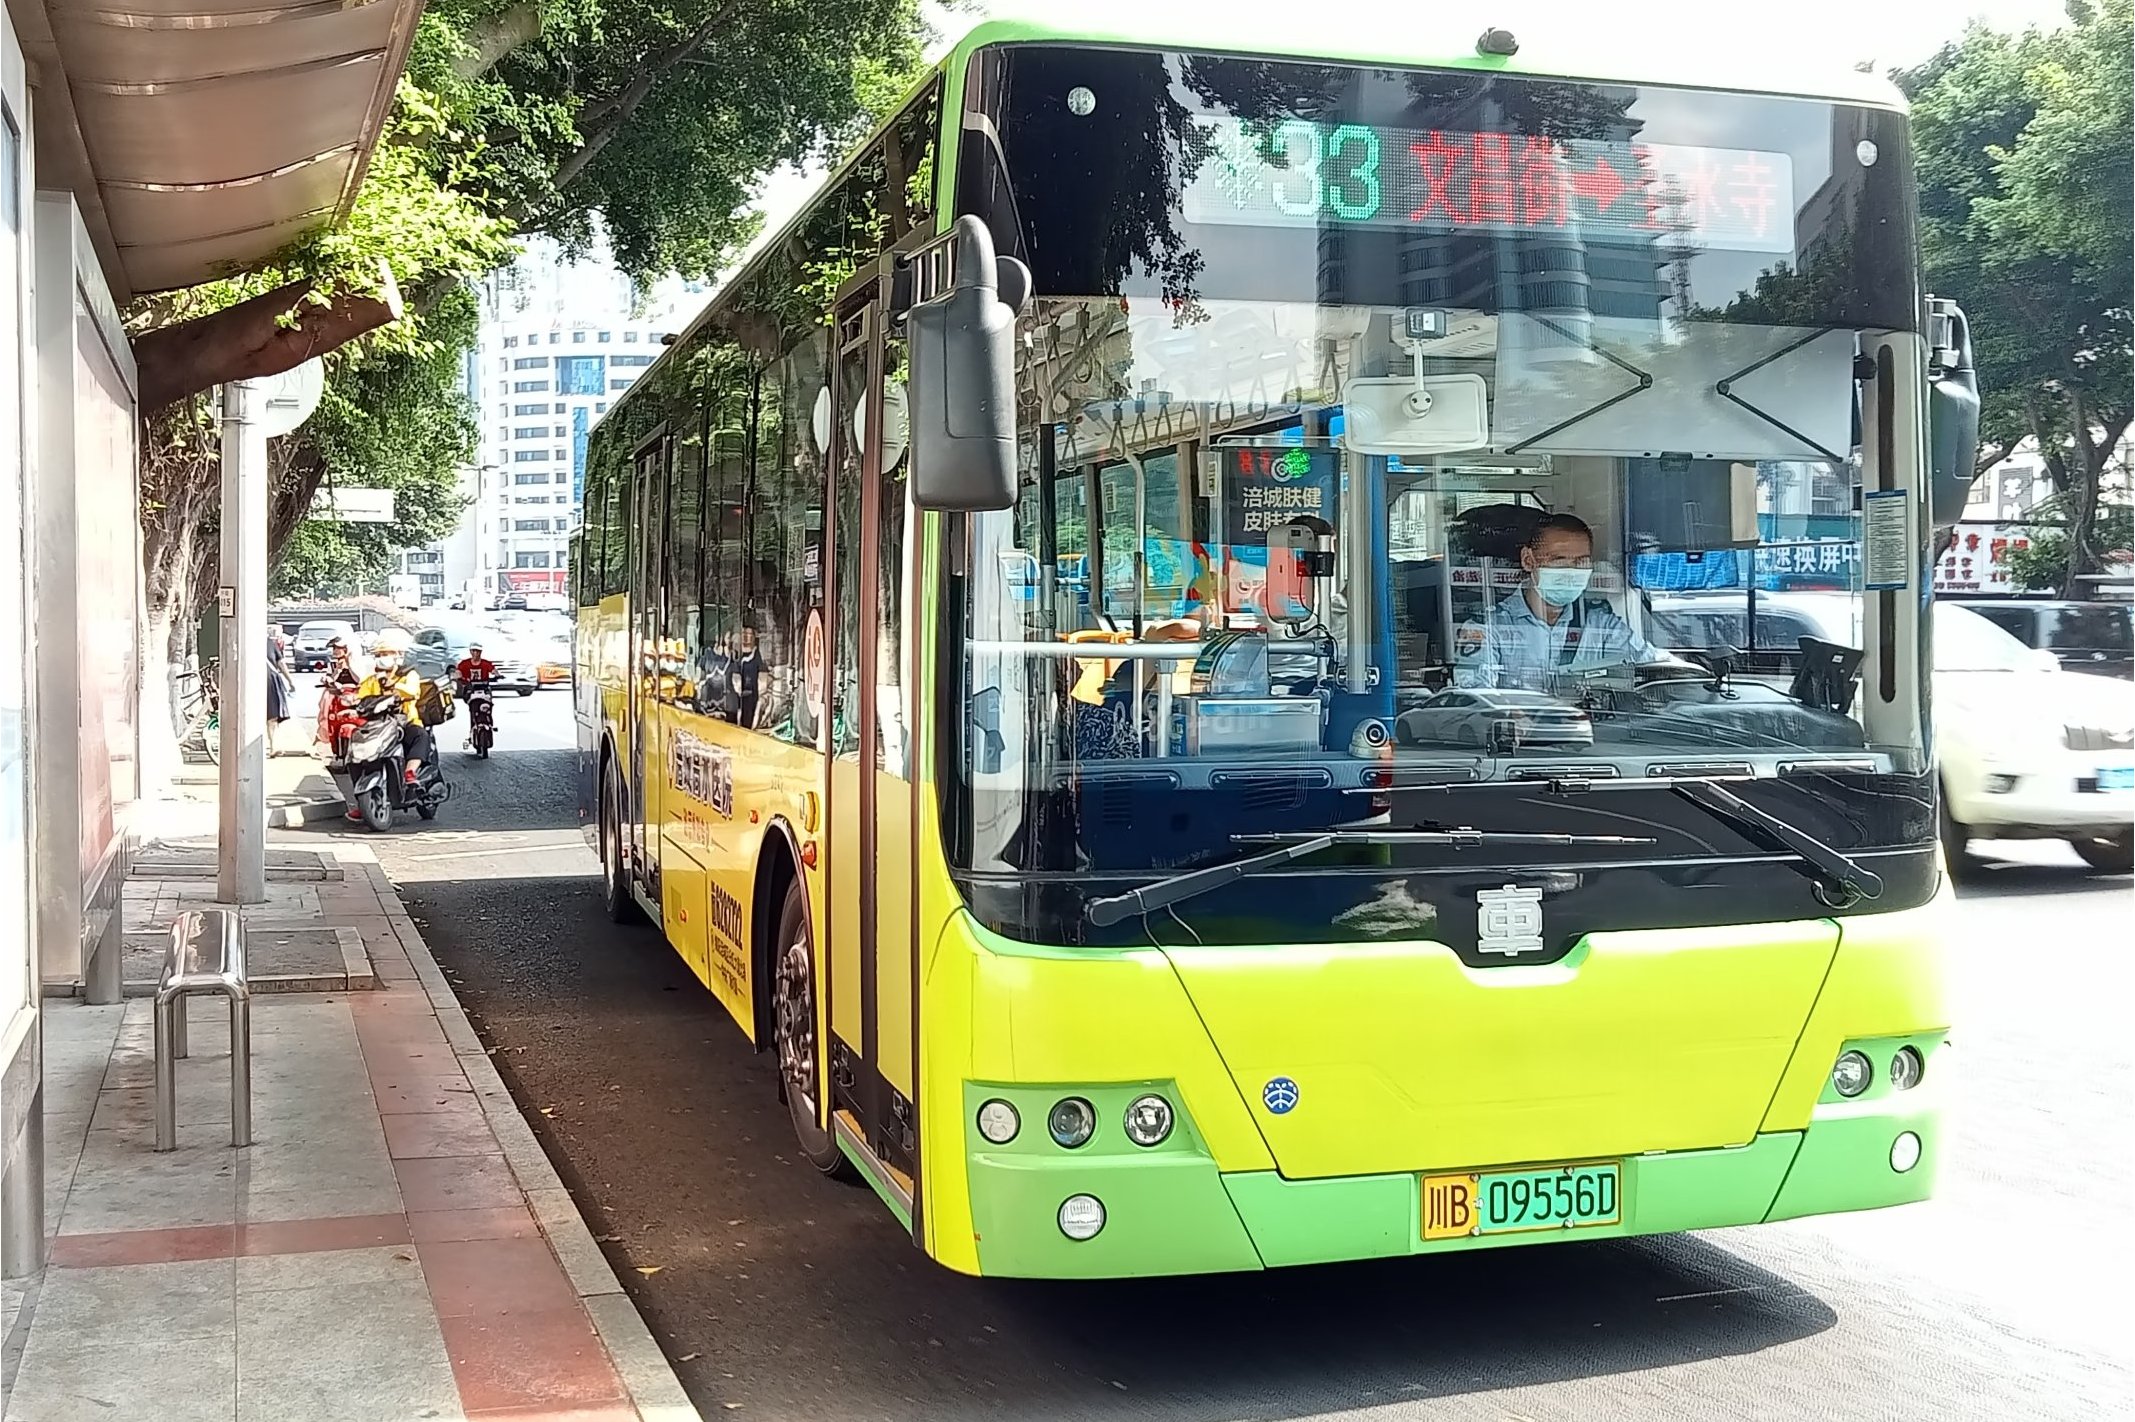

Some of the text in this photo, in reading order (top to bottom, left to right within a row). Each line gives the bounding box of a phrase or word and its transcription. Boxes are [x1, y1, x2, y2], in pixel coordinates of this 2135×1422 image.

[1272, 120, 1380, 220] 33
[1242, 486, 1322, 509] 涪城肤健
[1242, 510, 1320, 532] 皮肤
[1427, 1172, 1617, 1231] 川B 09556D
